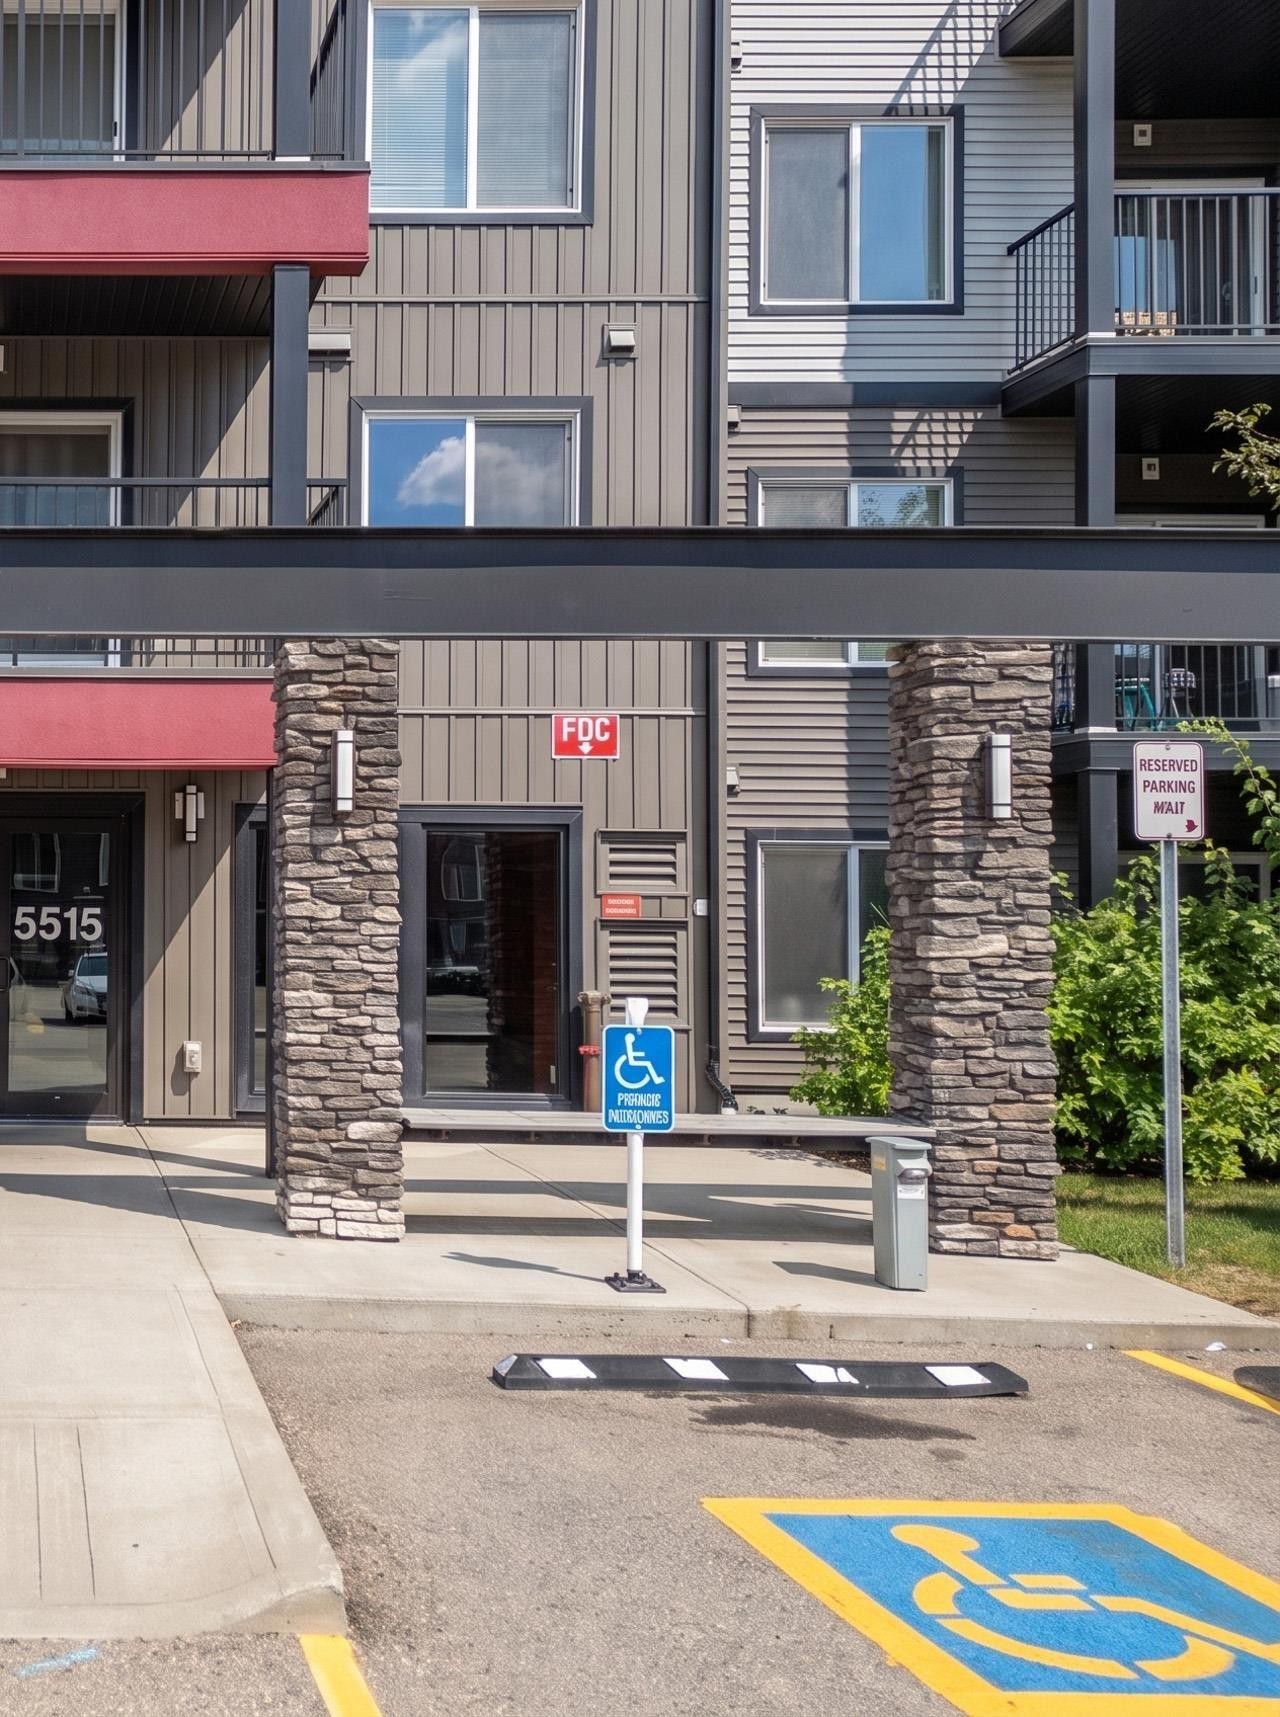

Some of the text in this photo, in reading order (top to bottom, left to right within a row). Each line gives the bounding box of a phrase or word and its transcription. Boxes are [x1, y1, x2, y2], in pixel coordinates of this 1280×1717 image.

[562, 717, 610, 742] FDC
[1139, 759, 1198, 772] RESERVED
[1143, 780, 1196, 793] PARKING
[14, 906, 102, 941] 5515
